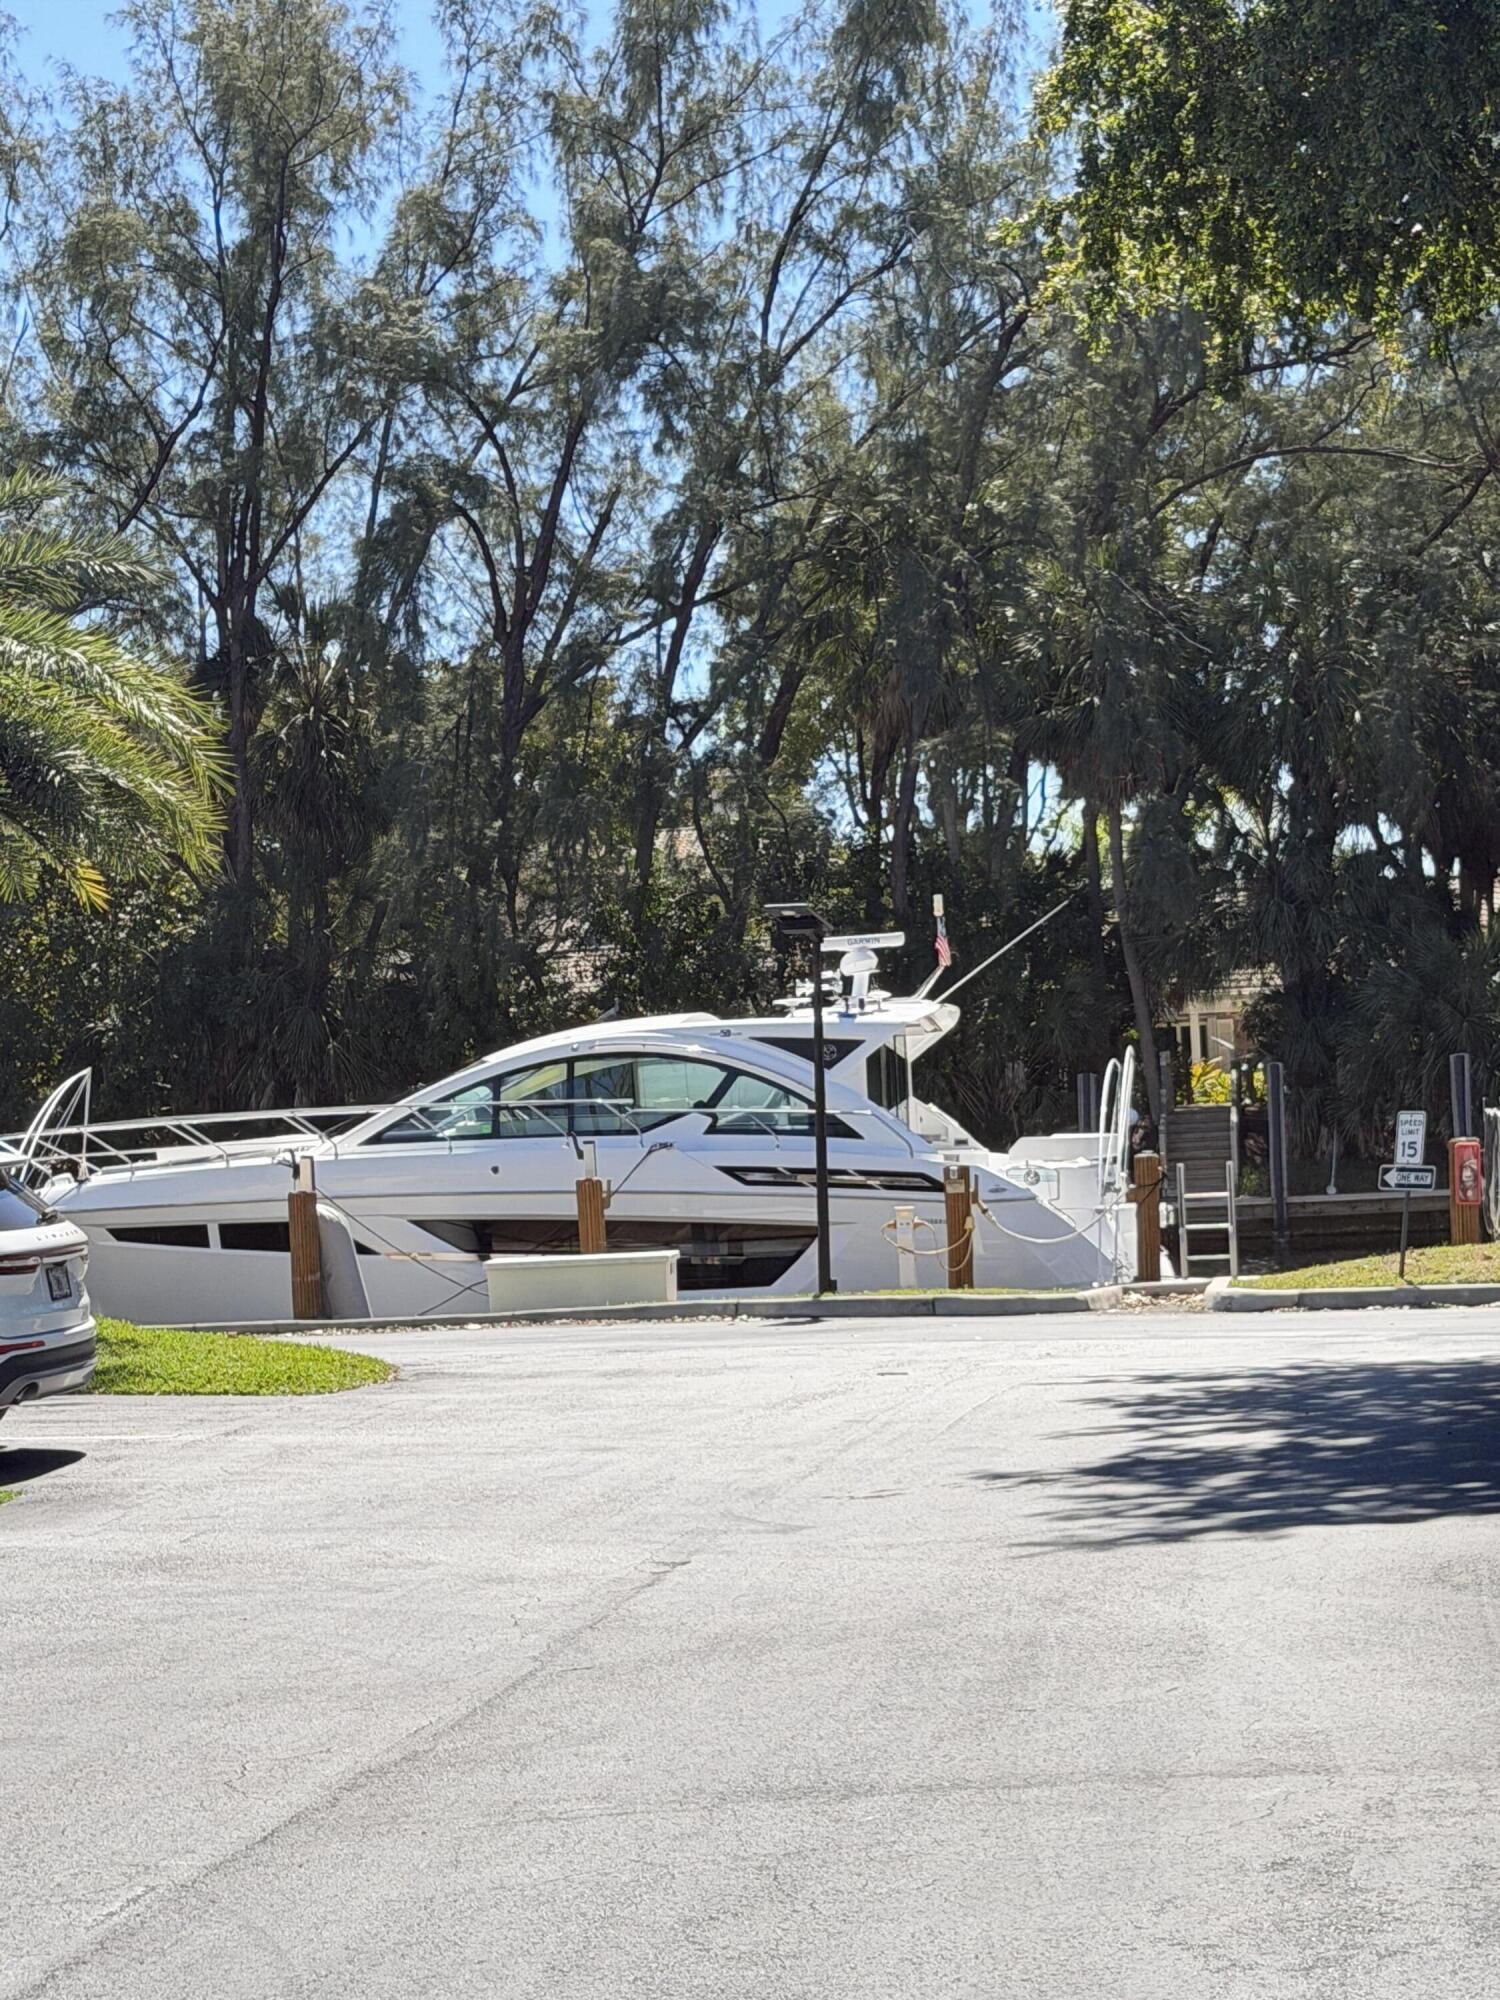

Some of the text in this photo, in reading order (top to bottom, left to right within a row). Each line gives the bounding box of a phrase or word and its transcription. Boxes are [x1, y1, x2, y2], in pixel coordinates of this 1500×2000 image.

[847, 937, 881, 945] GARMIN
[1400, 1119, 1424, 1127] SPEED
[1401, 1128, 1420, 1136] LIMIT
[1401, 1141, 1418, 1158] 15
[1396, 1173, 1429, 1182] ONE WAY
